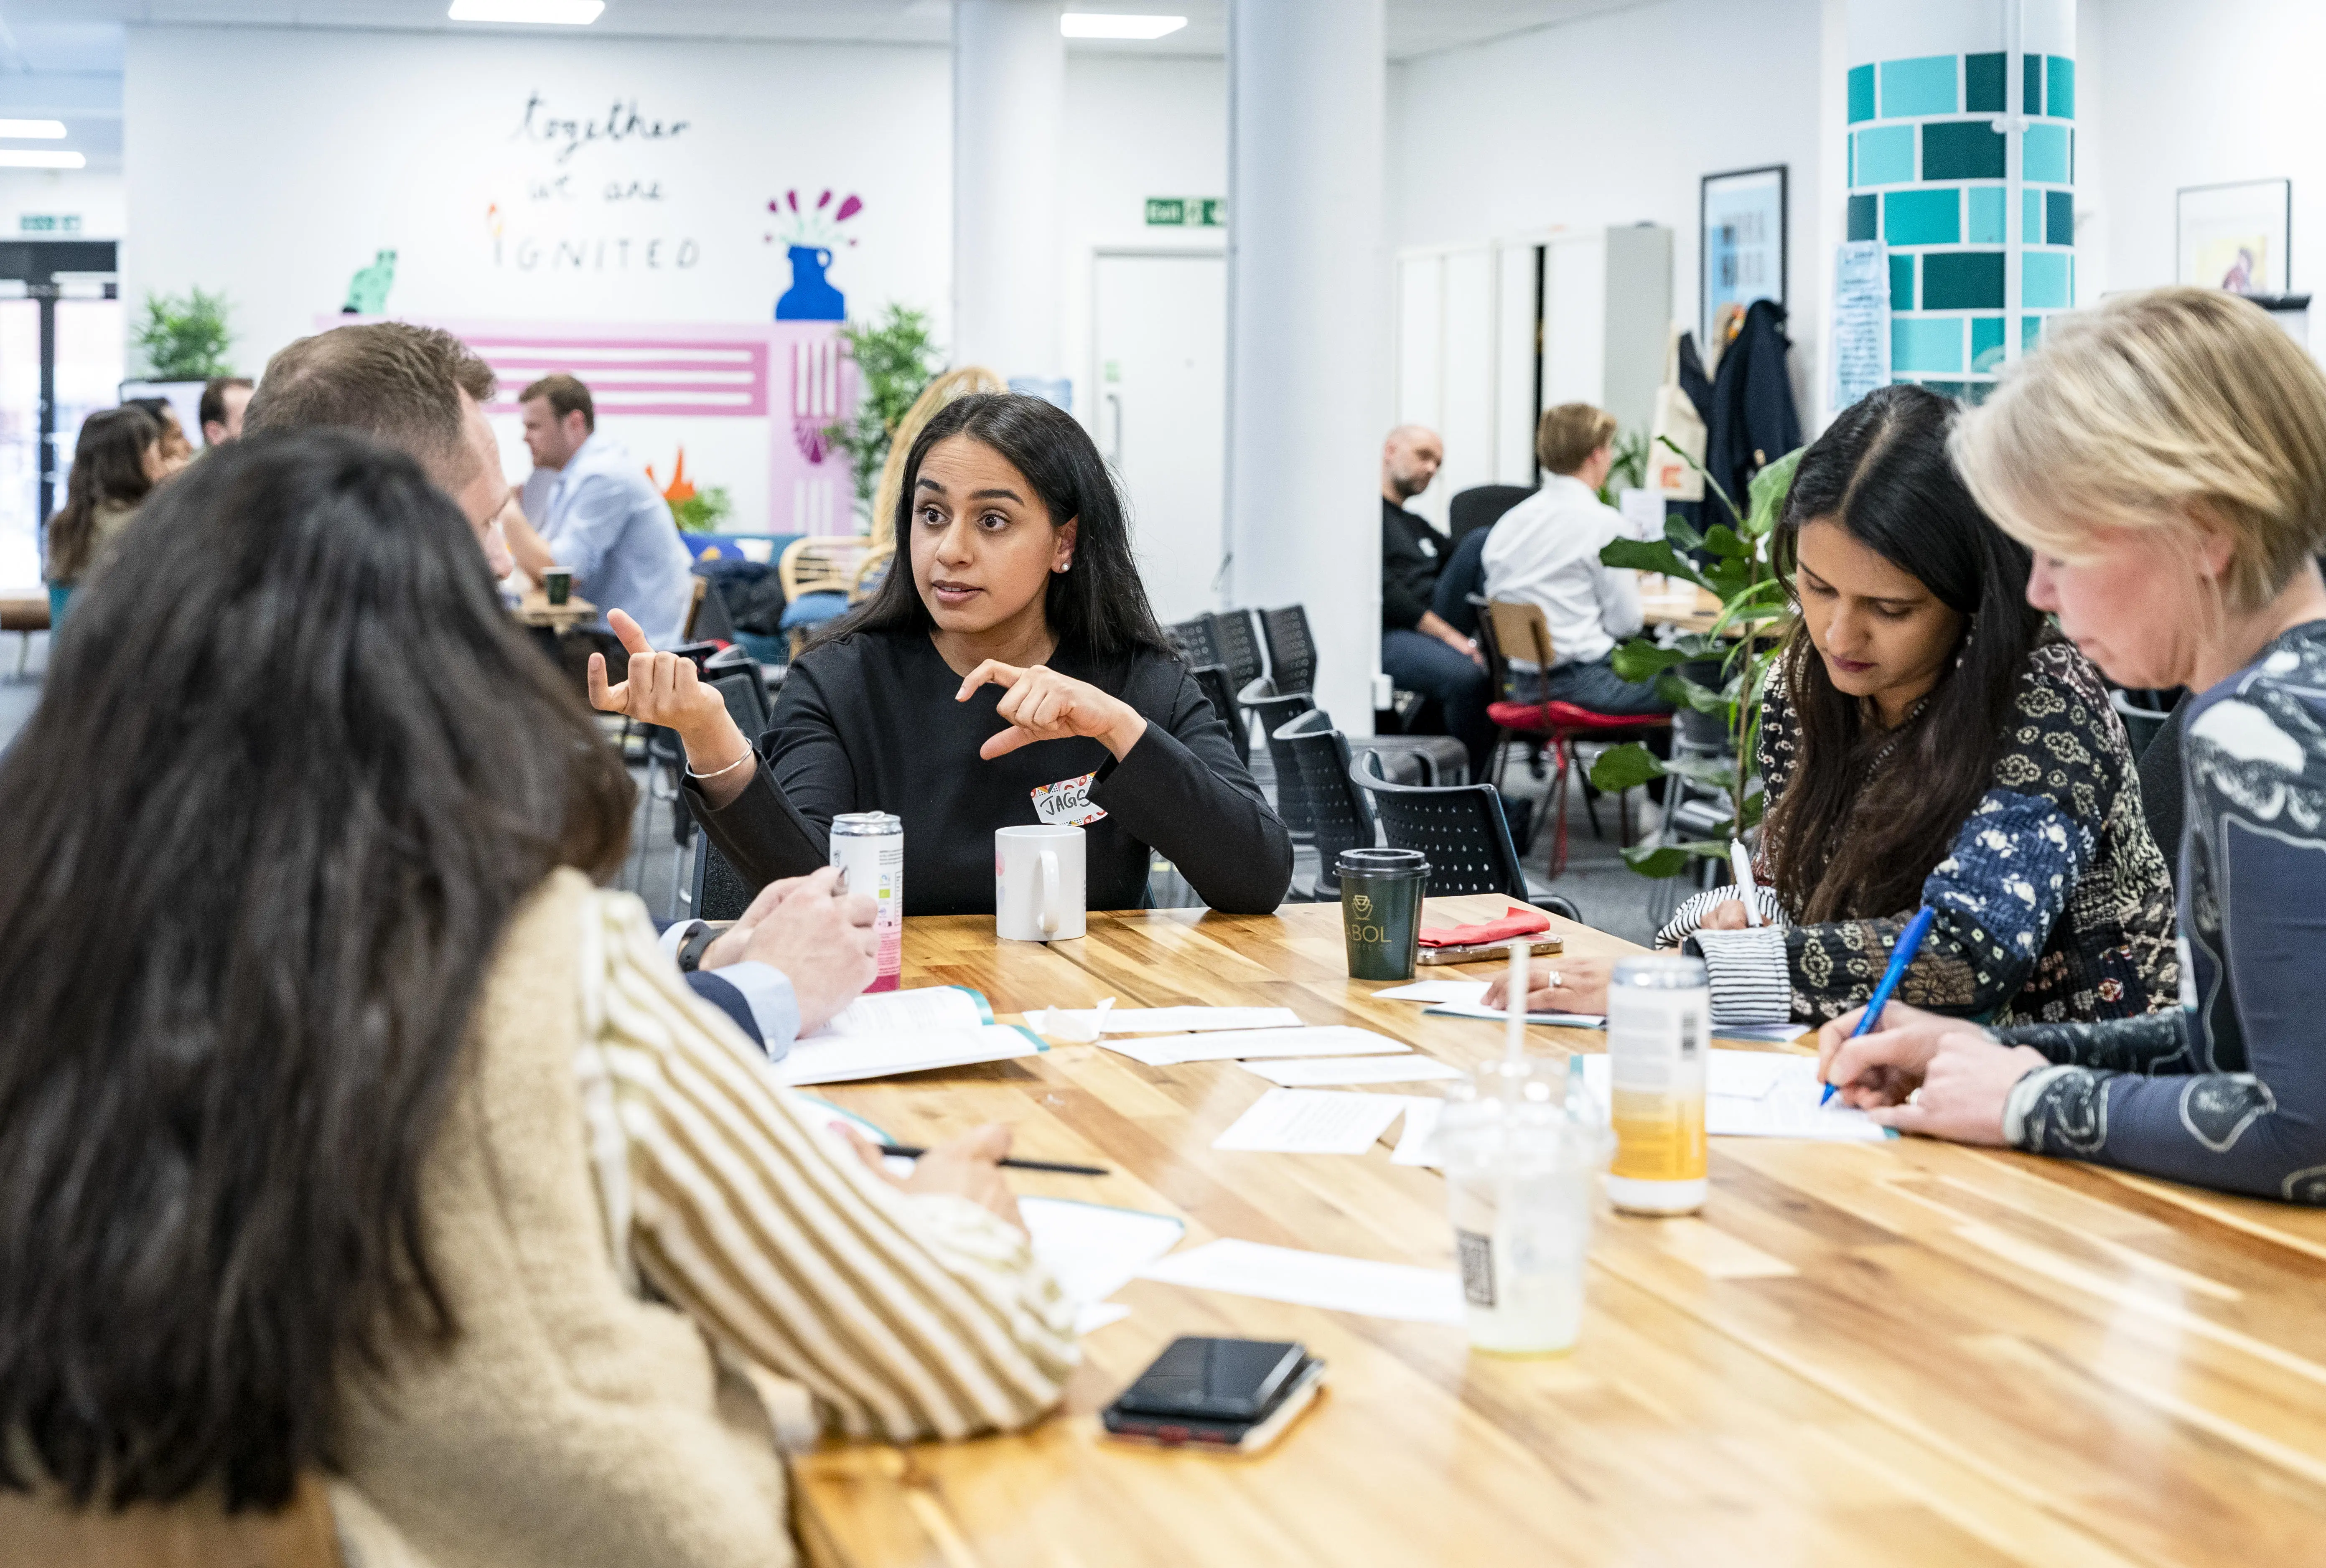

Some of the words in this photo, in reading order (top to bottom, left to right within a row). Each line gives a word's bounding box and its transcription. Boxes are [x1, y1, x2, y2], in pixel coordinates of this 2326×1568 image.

[507, 89, 691, 164] together
[529, 174, 577, 203] we
[603, 180, 669, 203] are
[495, 236, 700, 272] IGNITED
